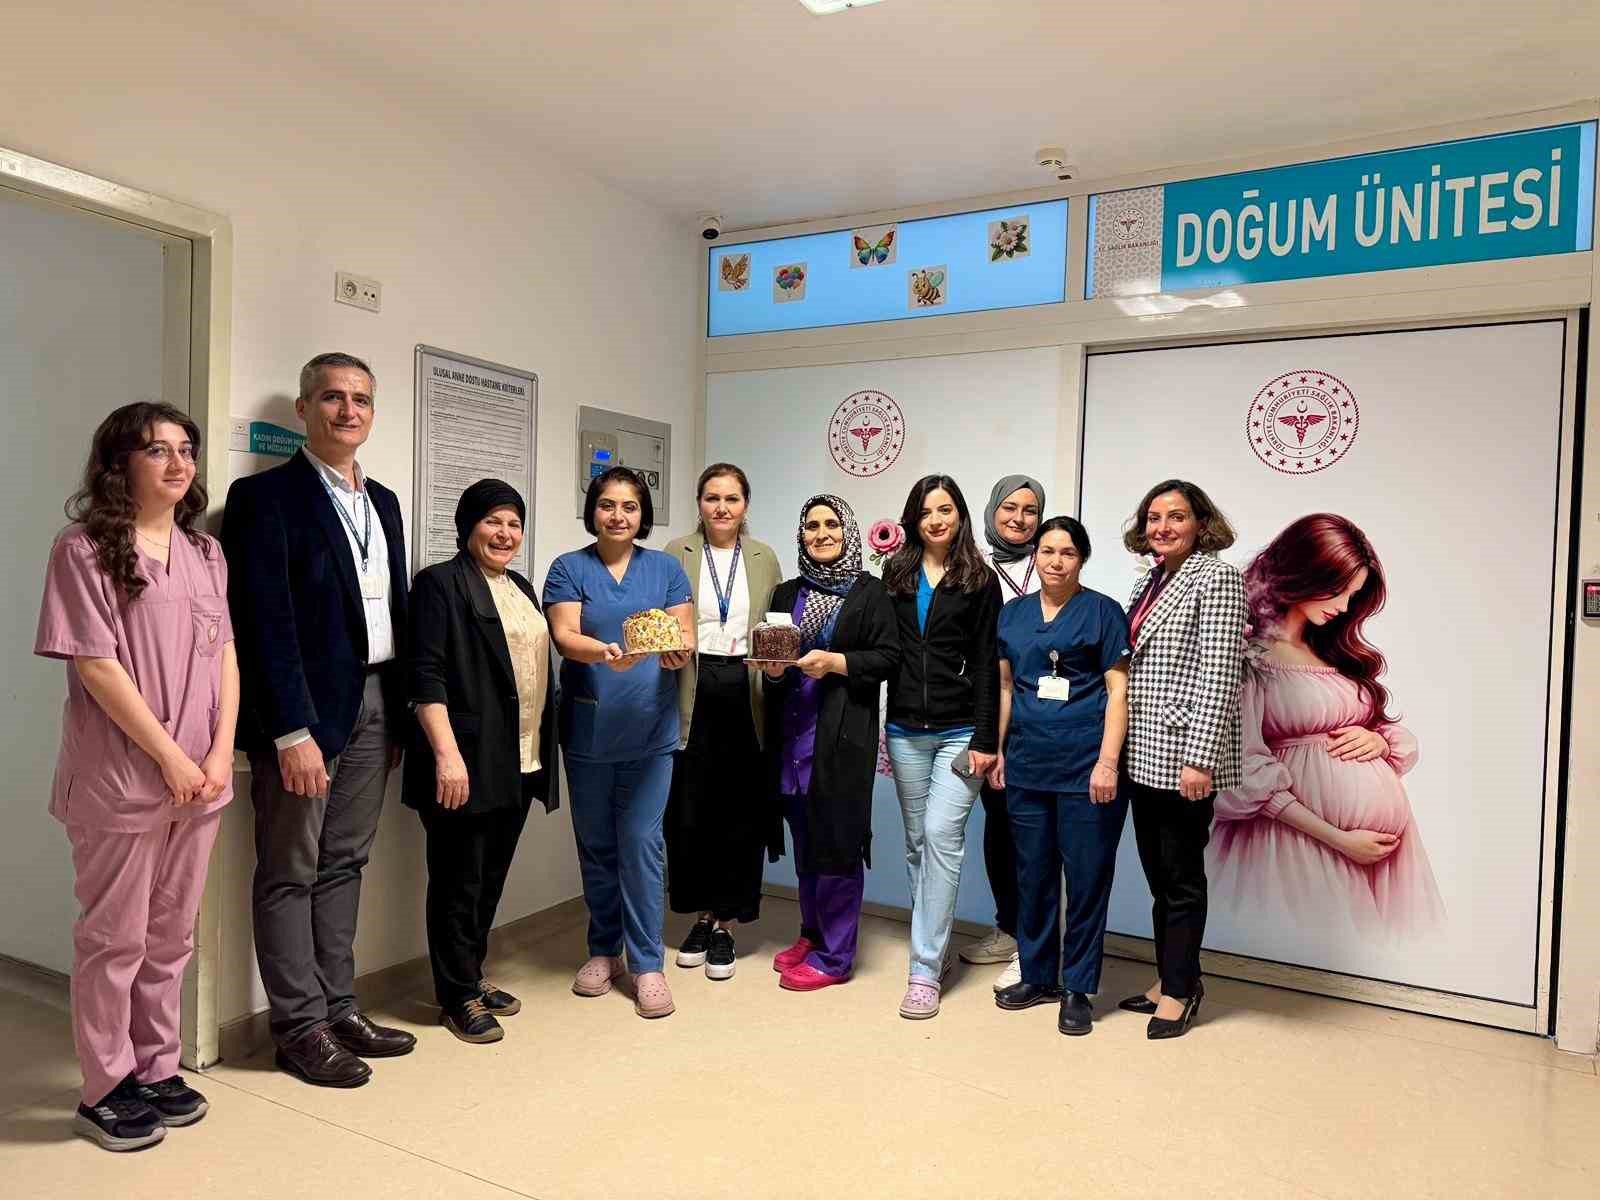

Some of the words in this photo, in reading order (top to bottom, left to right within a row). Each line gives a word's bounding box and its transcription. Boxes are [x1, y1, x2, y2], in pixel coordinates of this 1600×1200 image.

[1176, 189, 1337, 267] DOĞUM
[1354, 147, 1562, 248] ÜNİTESİ
[1266, 388, 1309, 423] CUMHURİYETİ
[1311, 390, 1335, 409] SAĞLIK
[1266, 425, 1286, 452] TÜRKİYE
